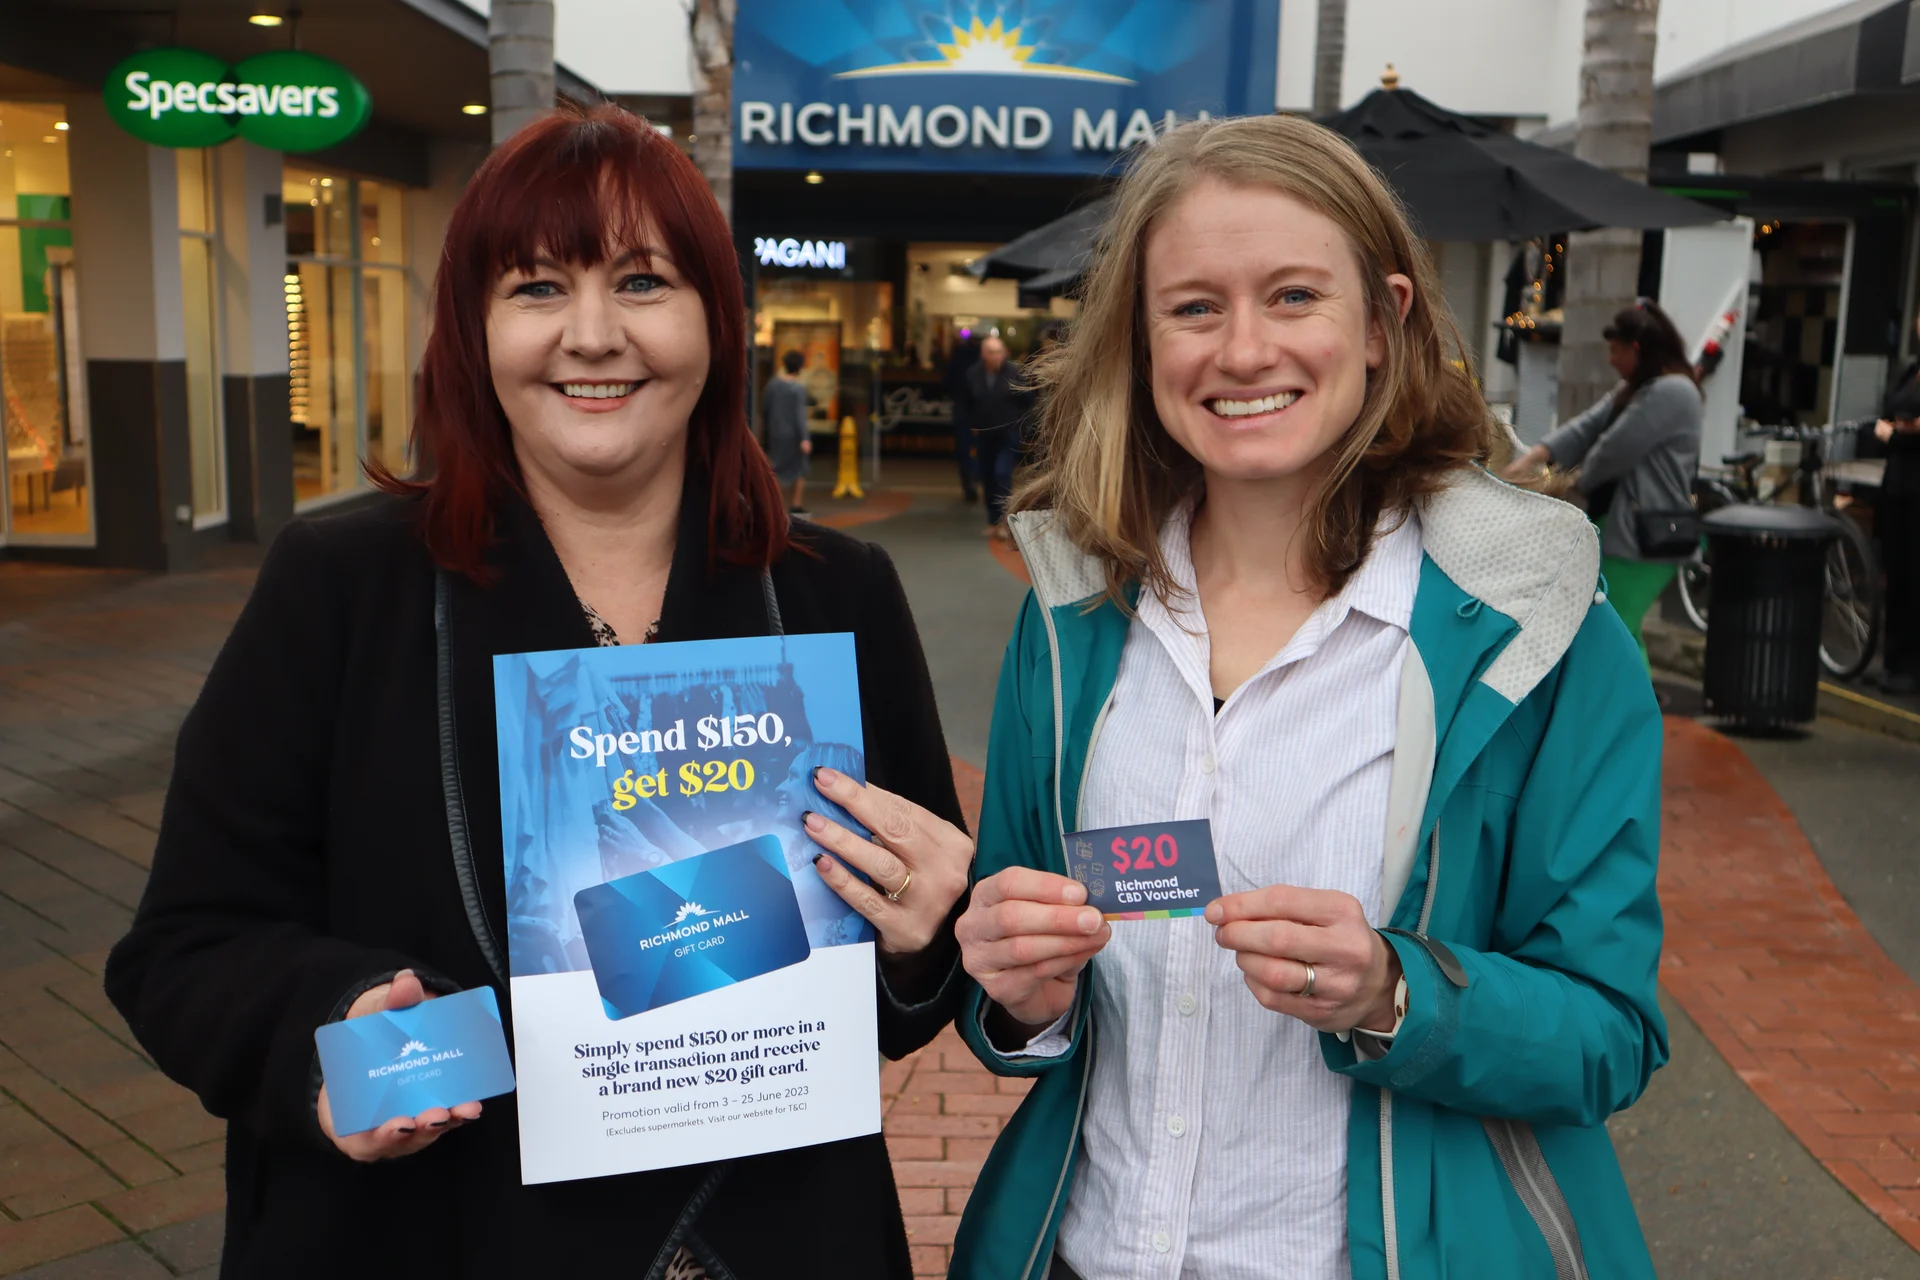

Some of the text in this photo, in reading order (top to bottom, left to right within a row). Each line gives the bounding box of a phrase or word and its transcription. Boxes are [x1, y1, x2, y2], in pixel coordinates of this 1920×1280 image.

[125, 71, 339, 120] Specsavers
[740, 101, 1210, 150] RICHMOND MA
[569, 712, 792, 767] Spend $150,
[611, 758, 755, 811] get $20
[1110, 833, 1179, 875] $20
[1115, 876, 1179, 892] Richmond
[1117, 887, 1201, 904] CBD Voucher
[639, 909, 750, 951] RICHMOND MALL
[674, 935, 725, 958] GIFT CARD
[574, 1020, 826, 1060] Simply spend $150 or more in a
[582, 1039, 821, 1080] single transaction and receive
[368, 1048, 464, 1079] RICHMOND MALL
[397, 1068, 443, 1086] GIFT CARD
[598, 1058, 808, 1096] a brand new $20 gift card.
[602, 1107, 661, 1121] Promotion
[663, 1101, 691, 1114] valid
[693, 1100, 719, 1111] from
[722, 1097, 729, 1107] 3
[741, 1093, 755, 1104] 25
[757, 1092, 782, 1103] June
[784, 1085, 810, 1099] 2023
[606, 1126, 646, 1137] (Excludes
[707, 1115, 726, 1124] Visit
[727, 1113, 742, 1121] our
[743, 1109, 774, 1119] website
[775, 1106, 787, 1115] for
[788, 1102, 808, 1113] T&C)
